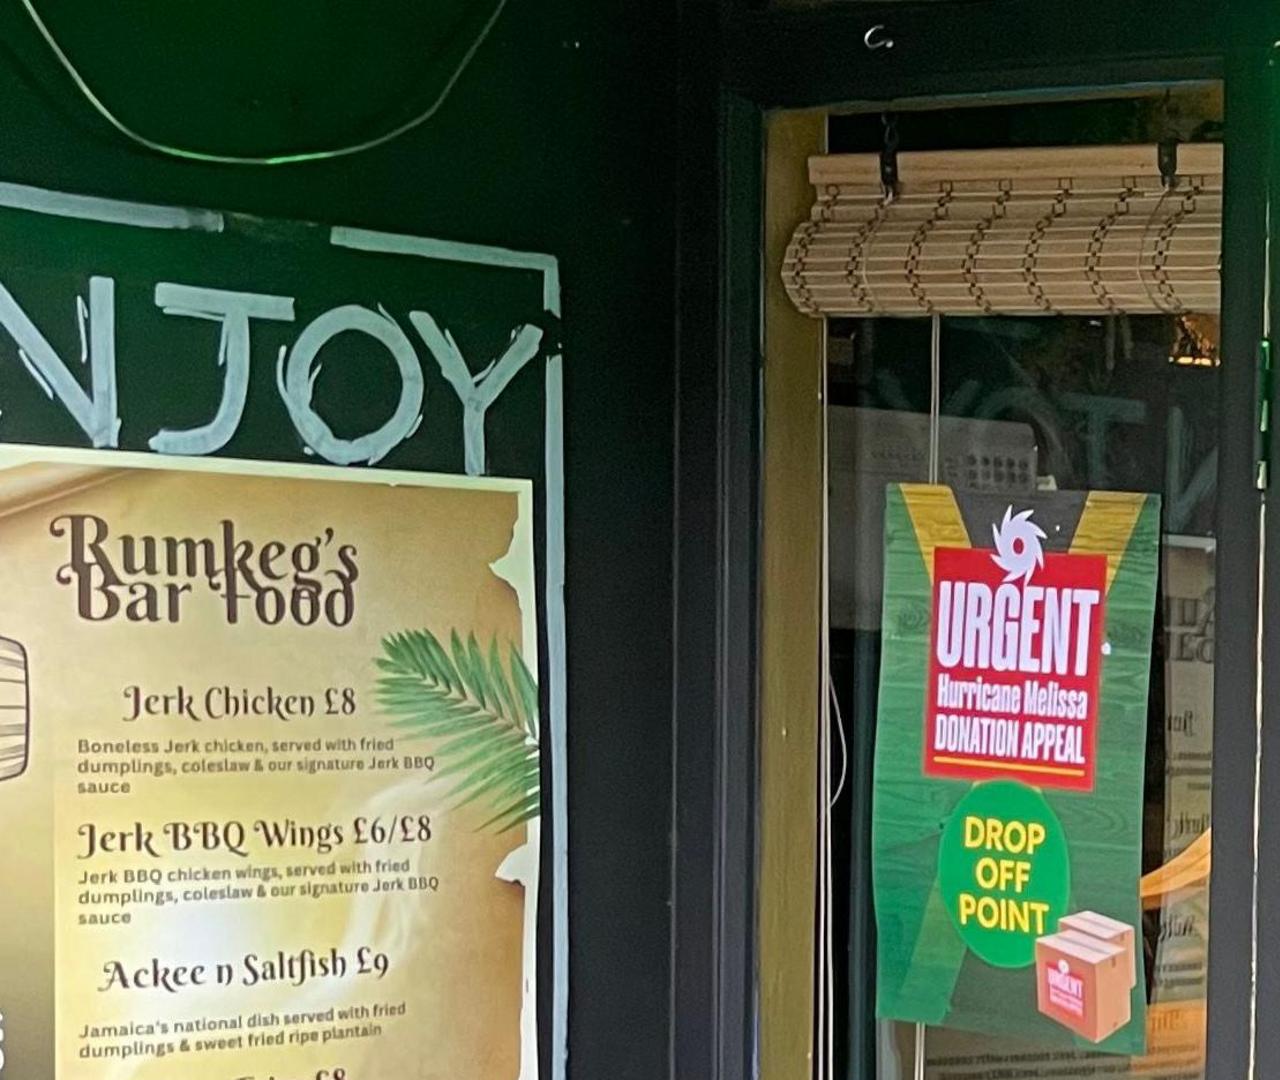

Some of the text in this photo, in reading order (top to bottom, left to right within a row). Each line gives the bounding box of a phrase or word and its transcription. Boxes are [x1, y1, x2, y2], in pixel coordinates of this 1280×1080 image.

[49, 513, 360, 596] Rumkeg's
[55, 561, 355, 627] Bar Food
[936, 580, 1100, 677] URGENT
[122, 686, 355, 721] Jerk Chicken £8
[938, 673, 1087, 720] Hurricane Melissa
[78, 738, 394, 754] Boneless Jerk chicken, served with fried
[934, 714, 1085, 764] DONATION APPEAL
[78, 758, 434, 777] dumplings, coleslaw & our signature Jerk BBQ
[78, 781, 130, 794] sauce
[78, 815, 432, 859] Jerk BBQ Wings £6/£8
[964, 816, 1046, 855] DROP
[79, 859, 409, 885] Jerk BBQ chicken wings, served with fried
[976, 858, 1031, 892] OFF
[78, 878, 439, 908] dumplings, coleslaw & our signature Jerk BBQ
[79, 912, 131, 925] sauce
[959, 894, 1049, 934] POINT
[97, 946, 389, 992] Ackee n Saltfish £9
[79, 1003, 405, 1039] Jamaica's national dish served with fried
[79, 1024, 382, 1059] dumplings & sweet fried ripe plantain
